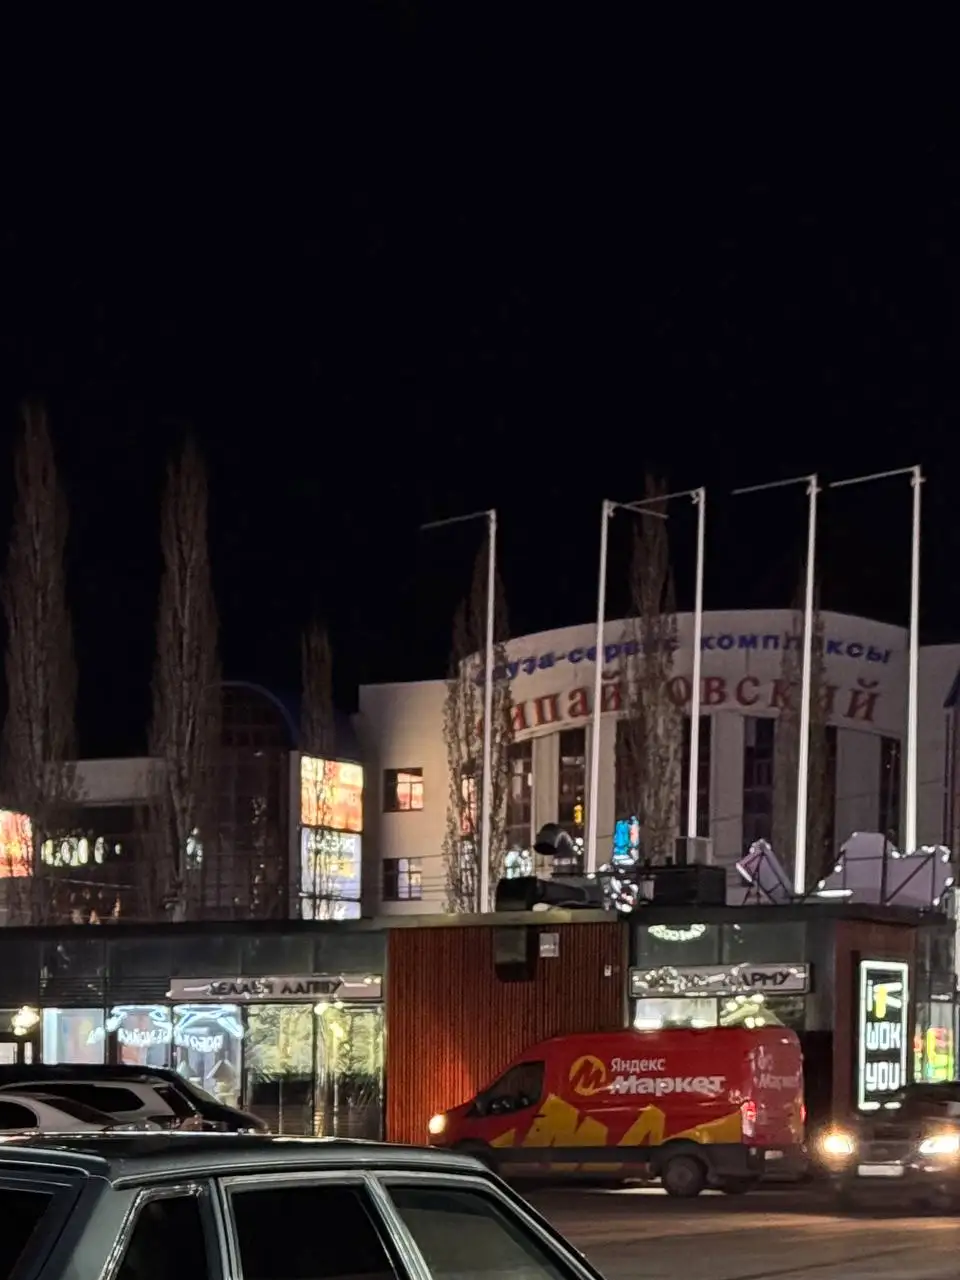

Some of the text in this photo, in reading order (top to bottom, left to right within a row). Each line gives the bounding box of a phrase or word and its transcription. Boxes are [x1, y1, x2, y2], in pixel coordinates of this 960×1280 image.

[698, 632, 892, 665] комплксы
[866, 1021, 902, 1050] WOK
[611, 1058, 666, 1072] Яндекс
[609, 1075, 726, 1097] Маркет
